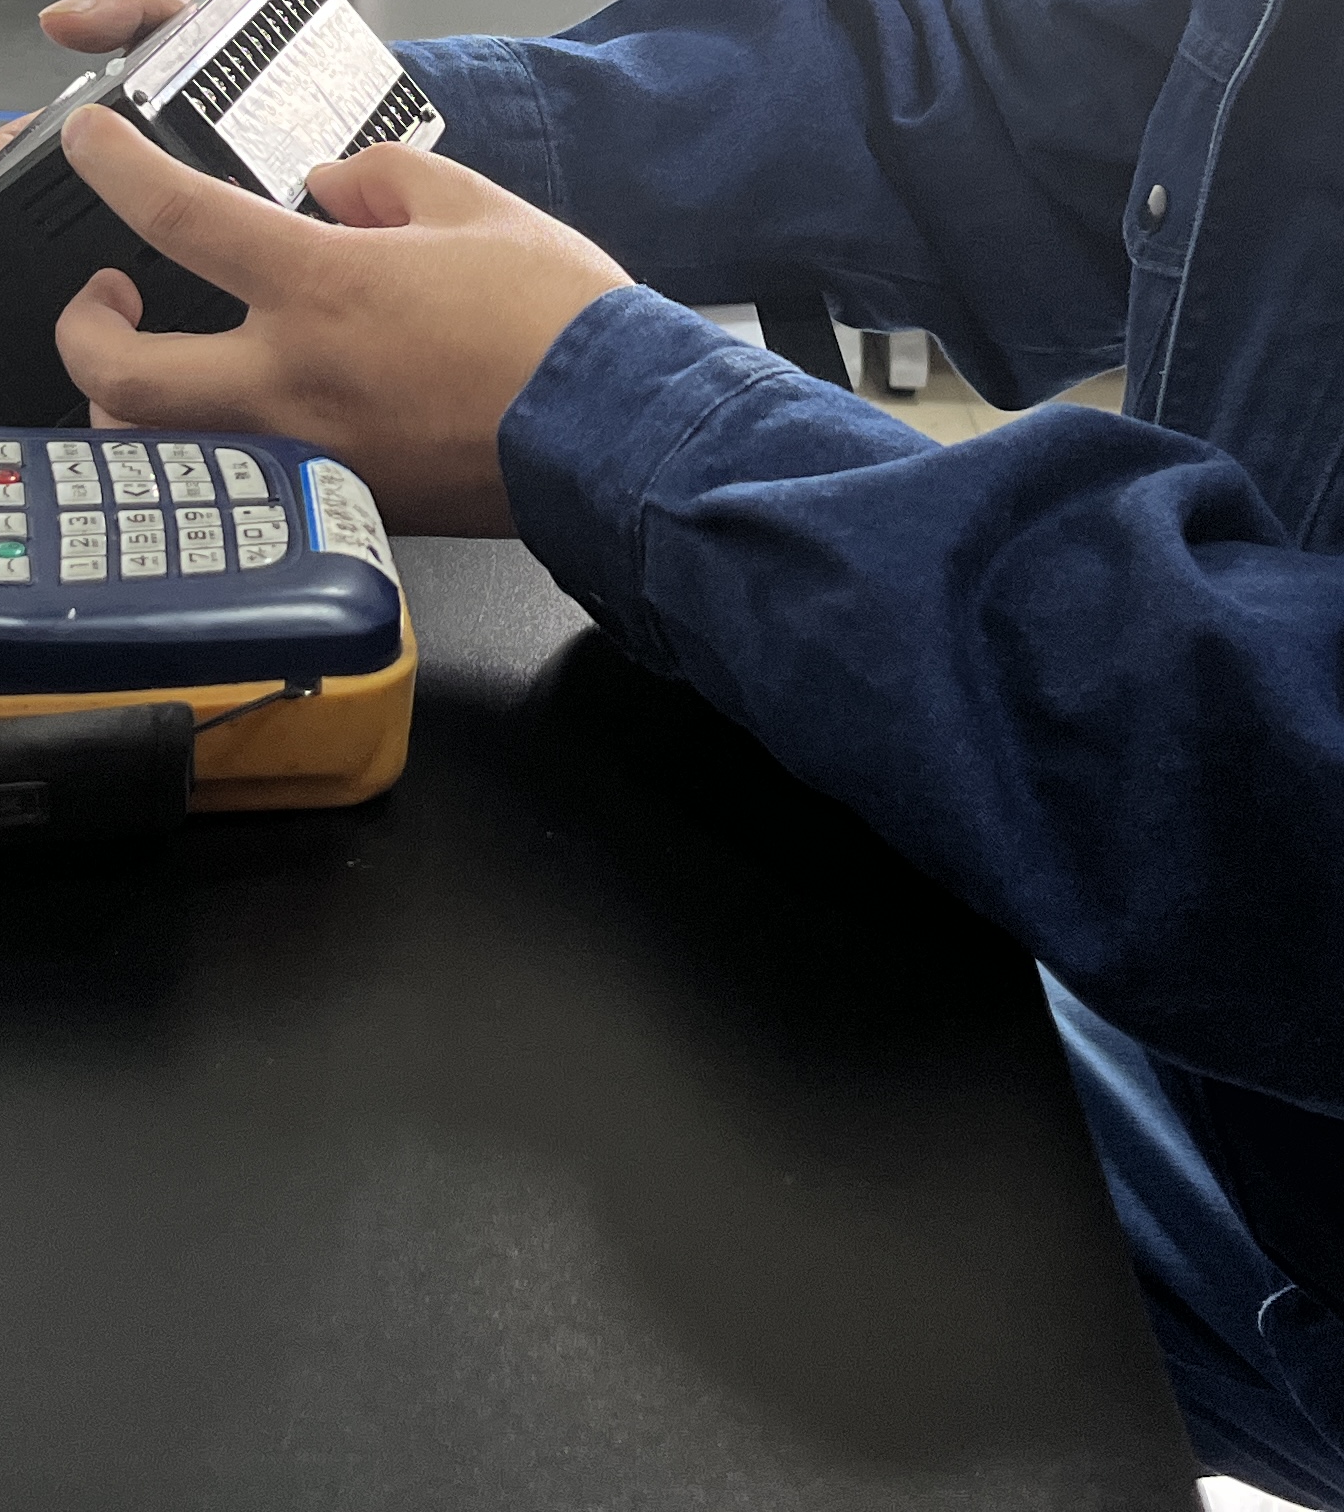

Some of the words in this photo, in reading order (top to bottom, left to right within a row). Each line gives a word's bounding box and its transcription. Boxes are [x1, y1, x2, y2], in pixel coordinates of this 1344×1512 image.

[68, 515, 88, 526] 3
[126, 513, 146, 523] 6
[184, 511, 204, 521] 9
[129, 533, 149, 544] 5
[187, 530, 206, 540] 8
[243, 527, 263, 539] 0
[70, 537, 90, 548] 2
[130, 554, 150, 566] 4
[188, 552, 210, 562] 7
